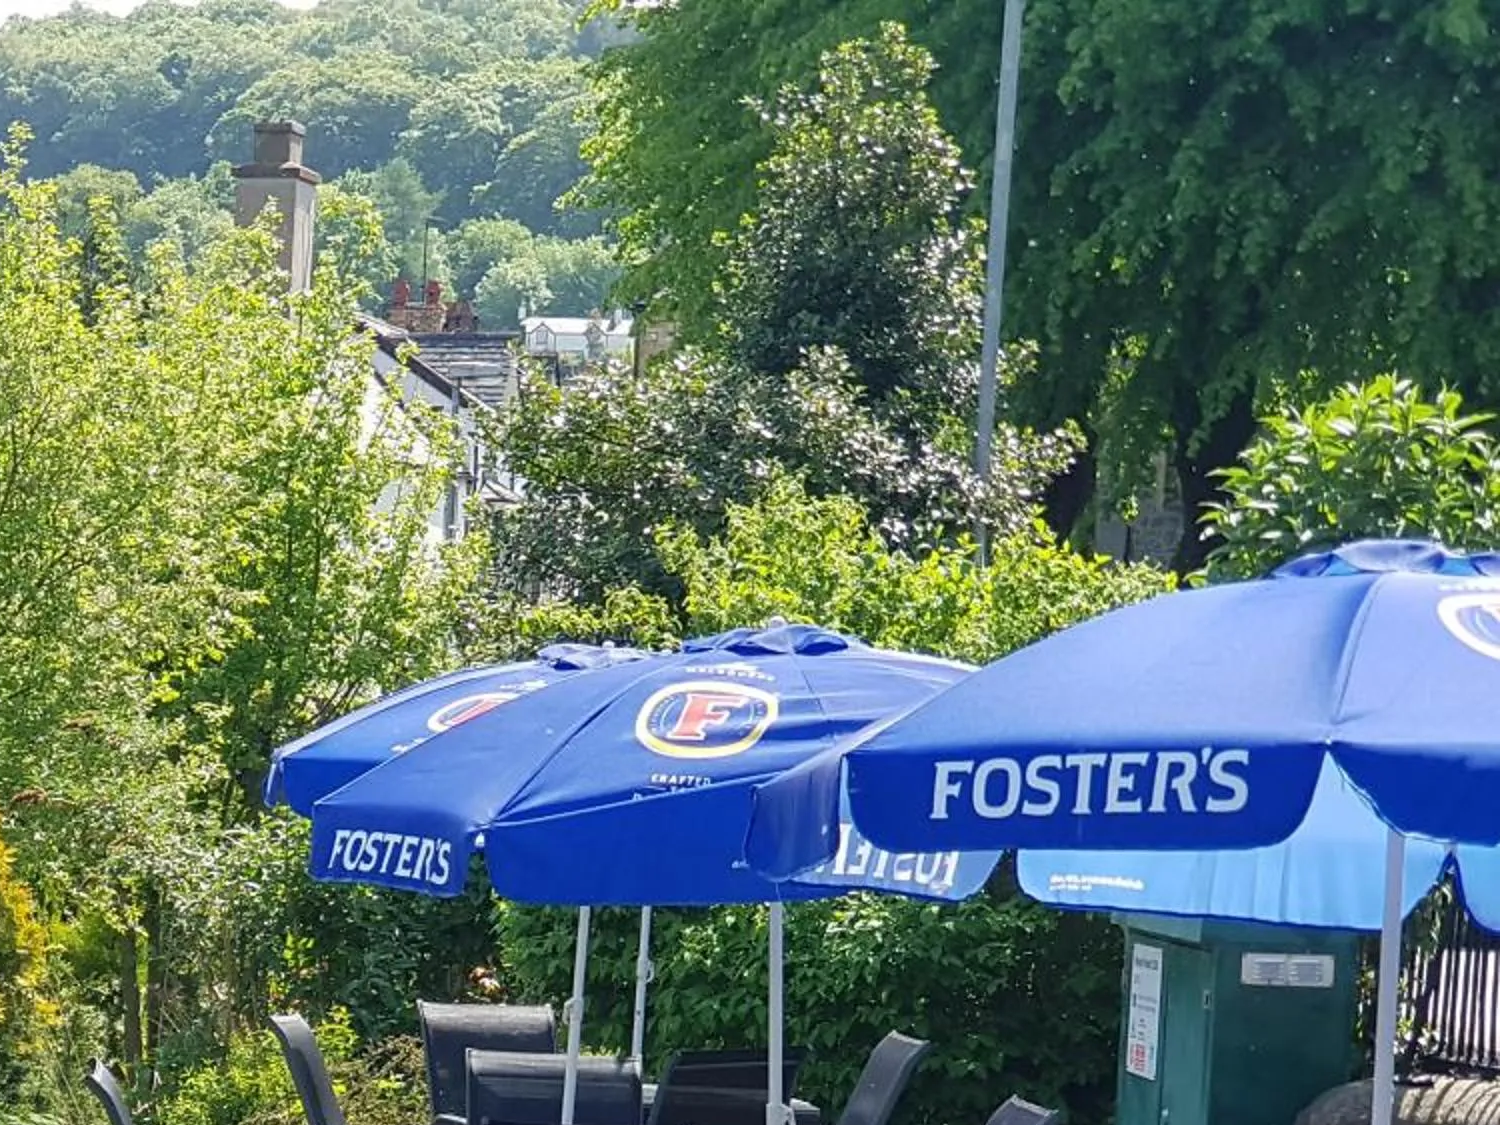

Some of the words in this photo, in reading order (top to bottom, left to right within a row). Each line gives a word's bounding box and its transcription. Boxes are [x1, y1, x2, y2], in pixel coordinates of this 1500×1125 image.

[666, 693, 747, 740] F
[929, 747, 1249, 819] FOSTER'S
[327, 829, 452, 885] FOSTER'S
